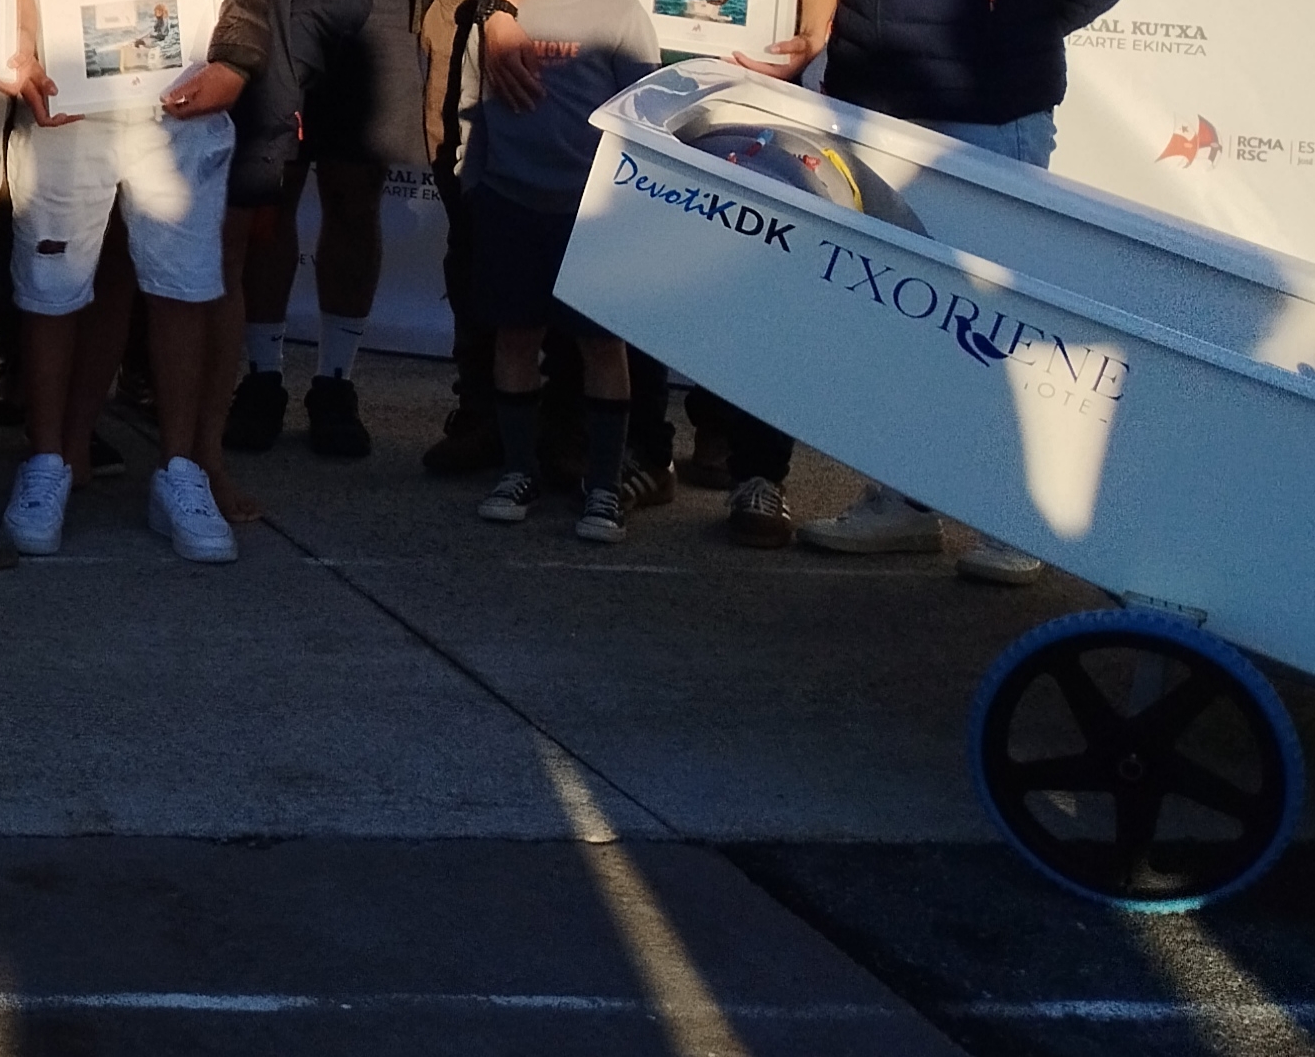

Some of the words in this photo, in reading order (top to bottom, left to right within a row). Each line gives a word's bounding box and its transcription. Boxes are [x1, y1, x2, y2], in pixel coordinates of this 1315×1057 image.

[1130, 20, 1208, 41] KUTXA
[1067, 34, 1127, 50] IZARTE
[1132, 38, 1207, 57] EKINTZA
[1236, 135, 1285, 151] RCMA
[1236, 148, 1268, 162] RSC
[819, 239, 1130, 401] TXORIENE
